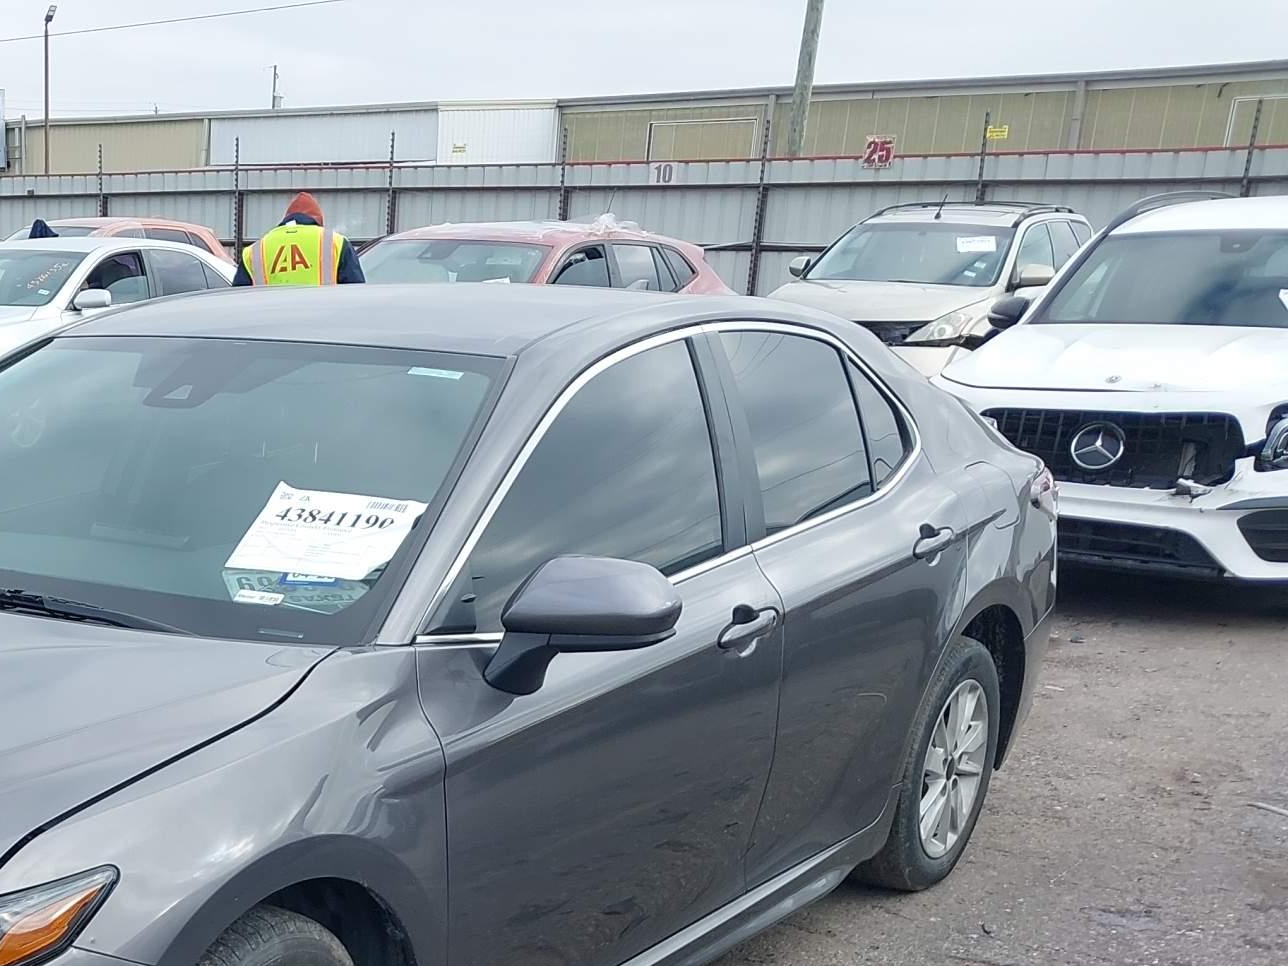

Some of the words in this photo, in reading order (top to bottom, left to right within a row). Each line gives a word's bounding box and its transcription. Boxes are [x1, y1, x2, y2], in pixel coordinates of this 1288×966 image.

[864, 140, 893, 164] 25
[654, 164, 673, 183] 10
[275, 506, 395, 530] 43841190
